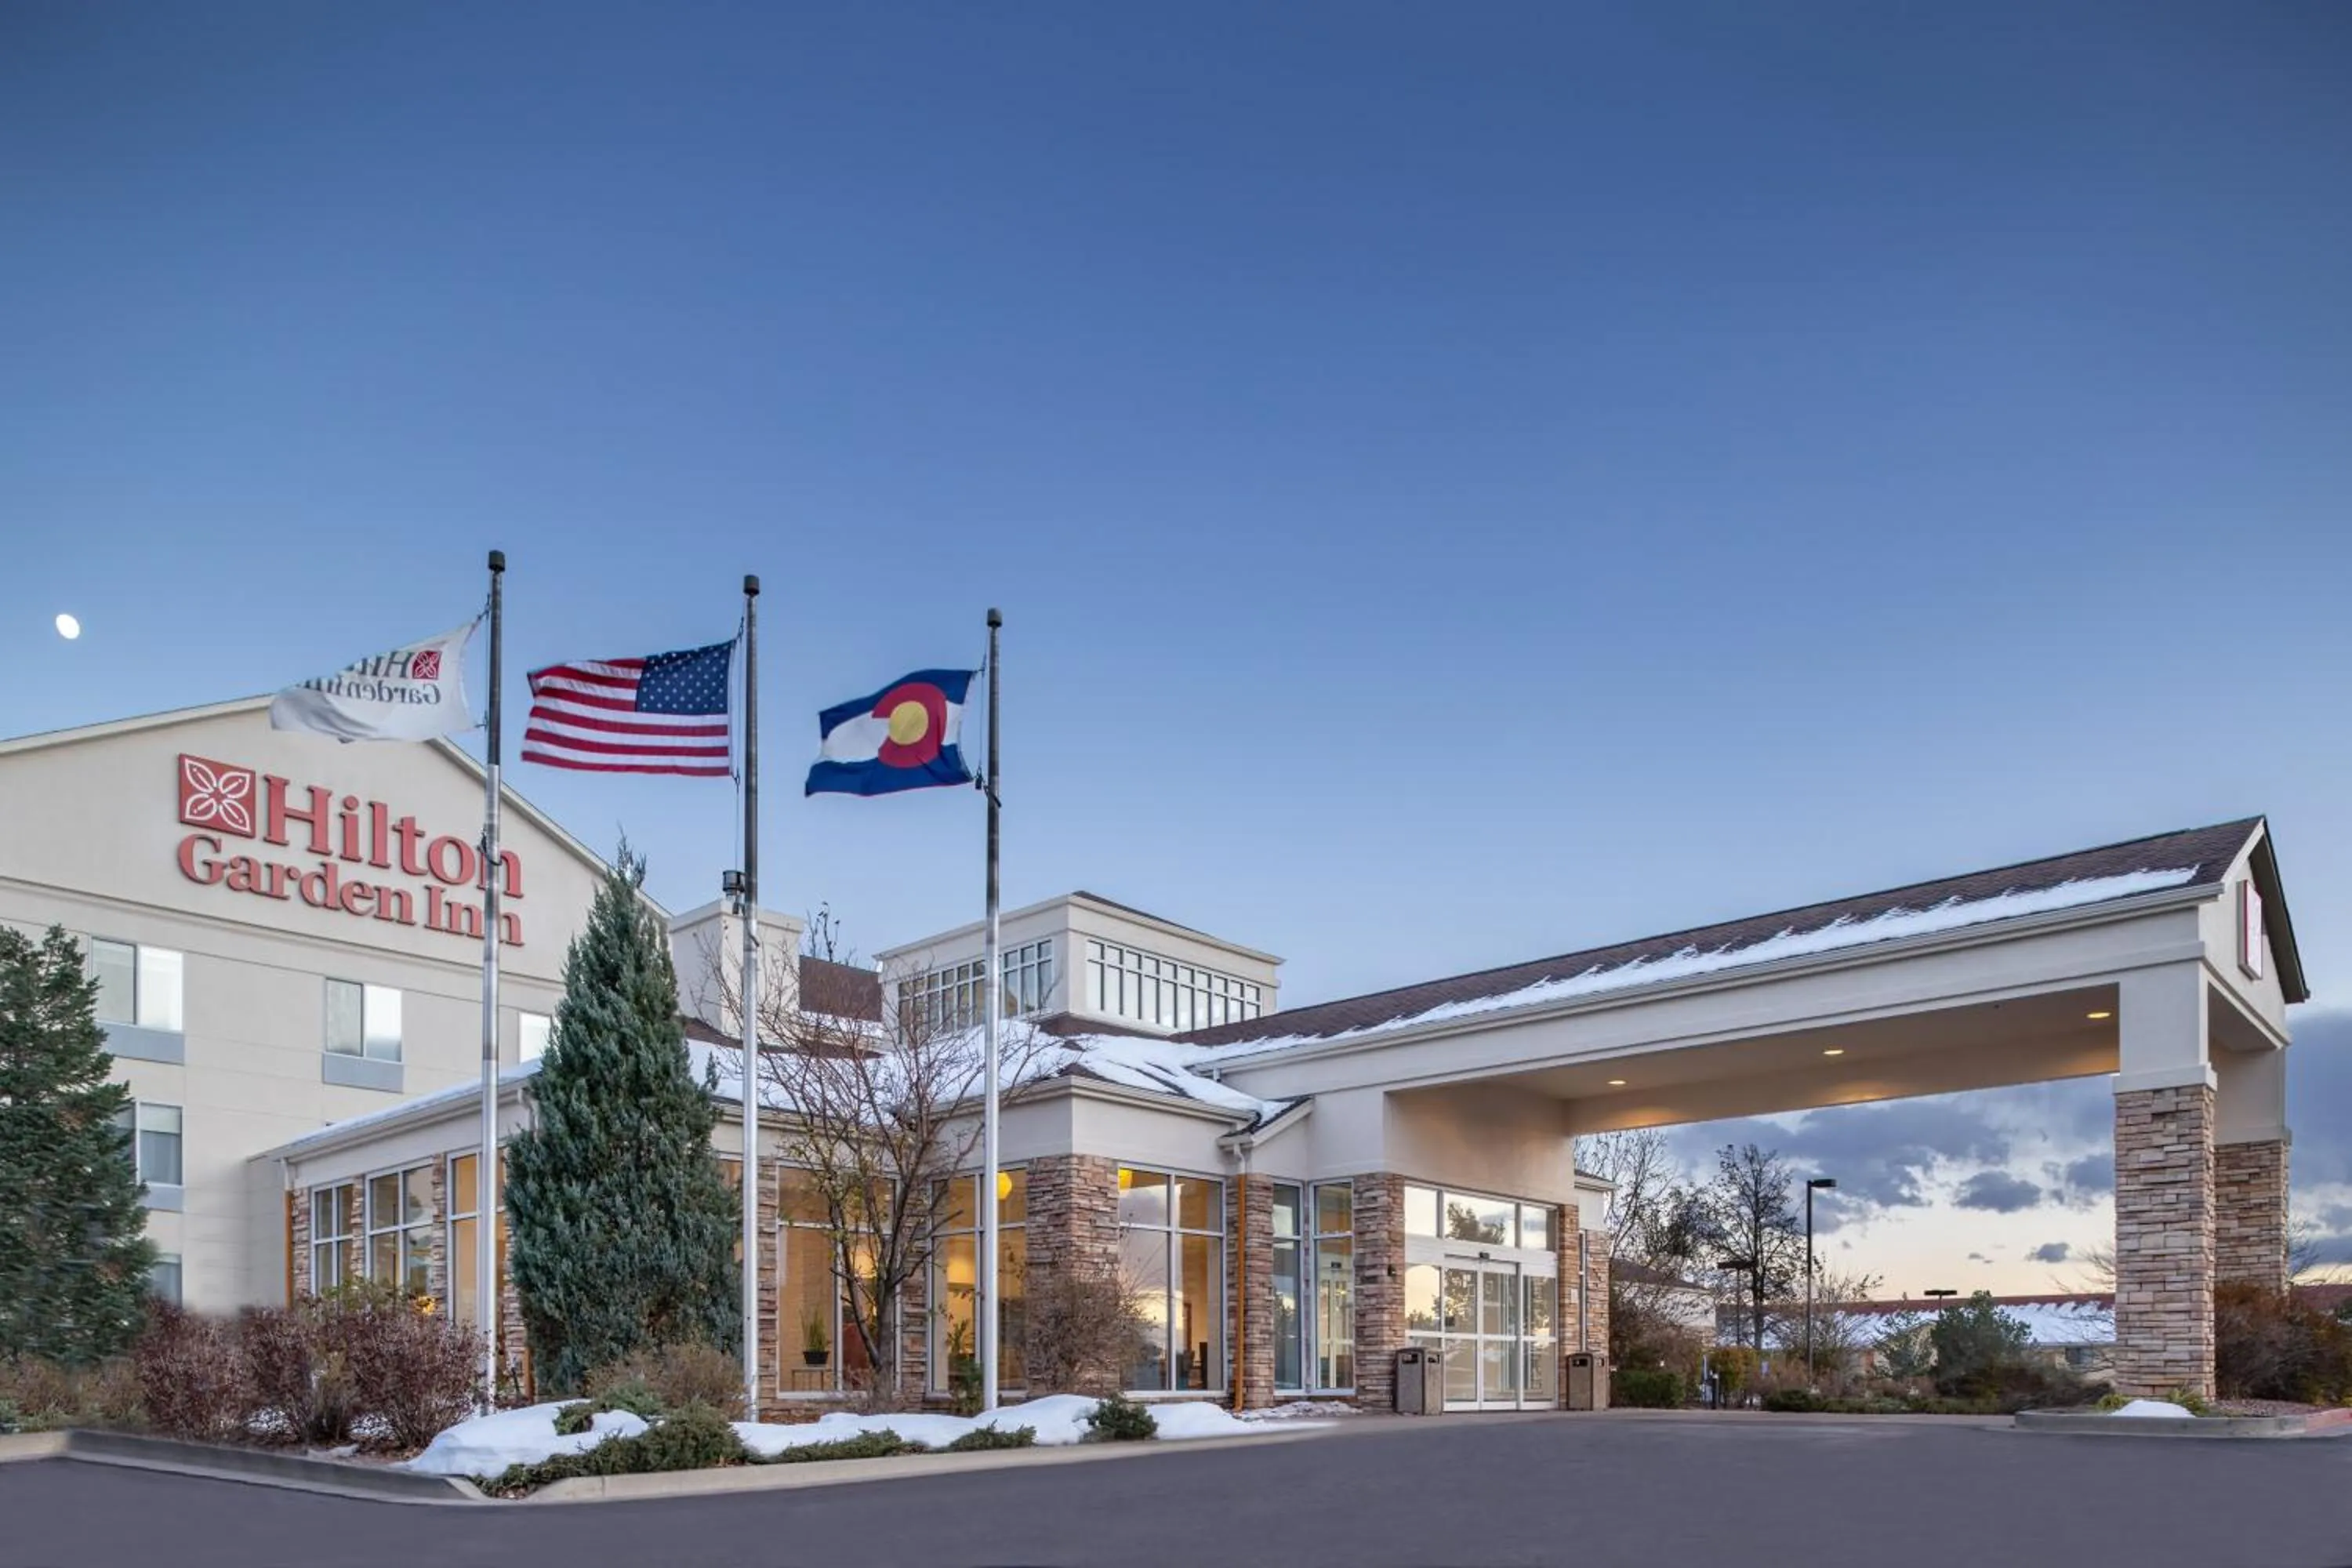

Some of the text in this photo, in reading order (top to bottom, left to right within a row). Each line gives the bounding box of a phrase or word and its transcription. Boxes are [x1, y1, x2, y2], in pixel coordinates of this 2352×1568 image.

[177, 833, 525, 947] Garden Inn
[263, 774, 524, 899] Hilton
